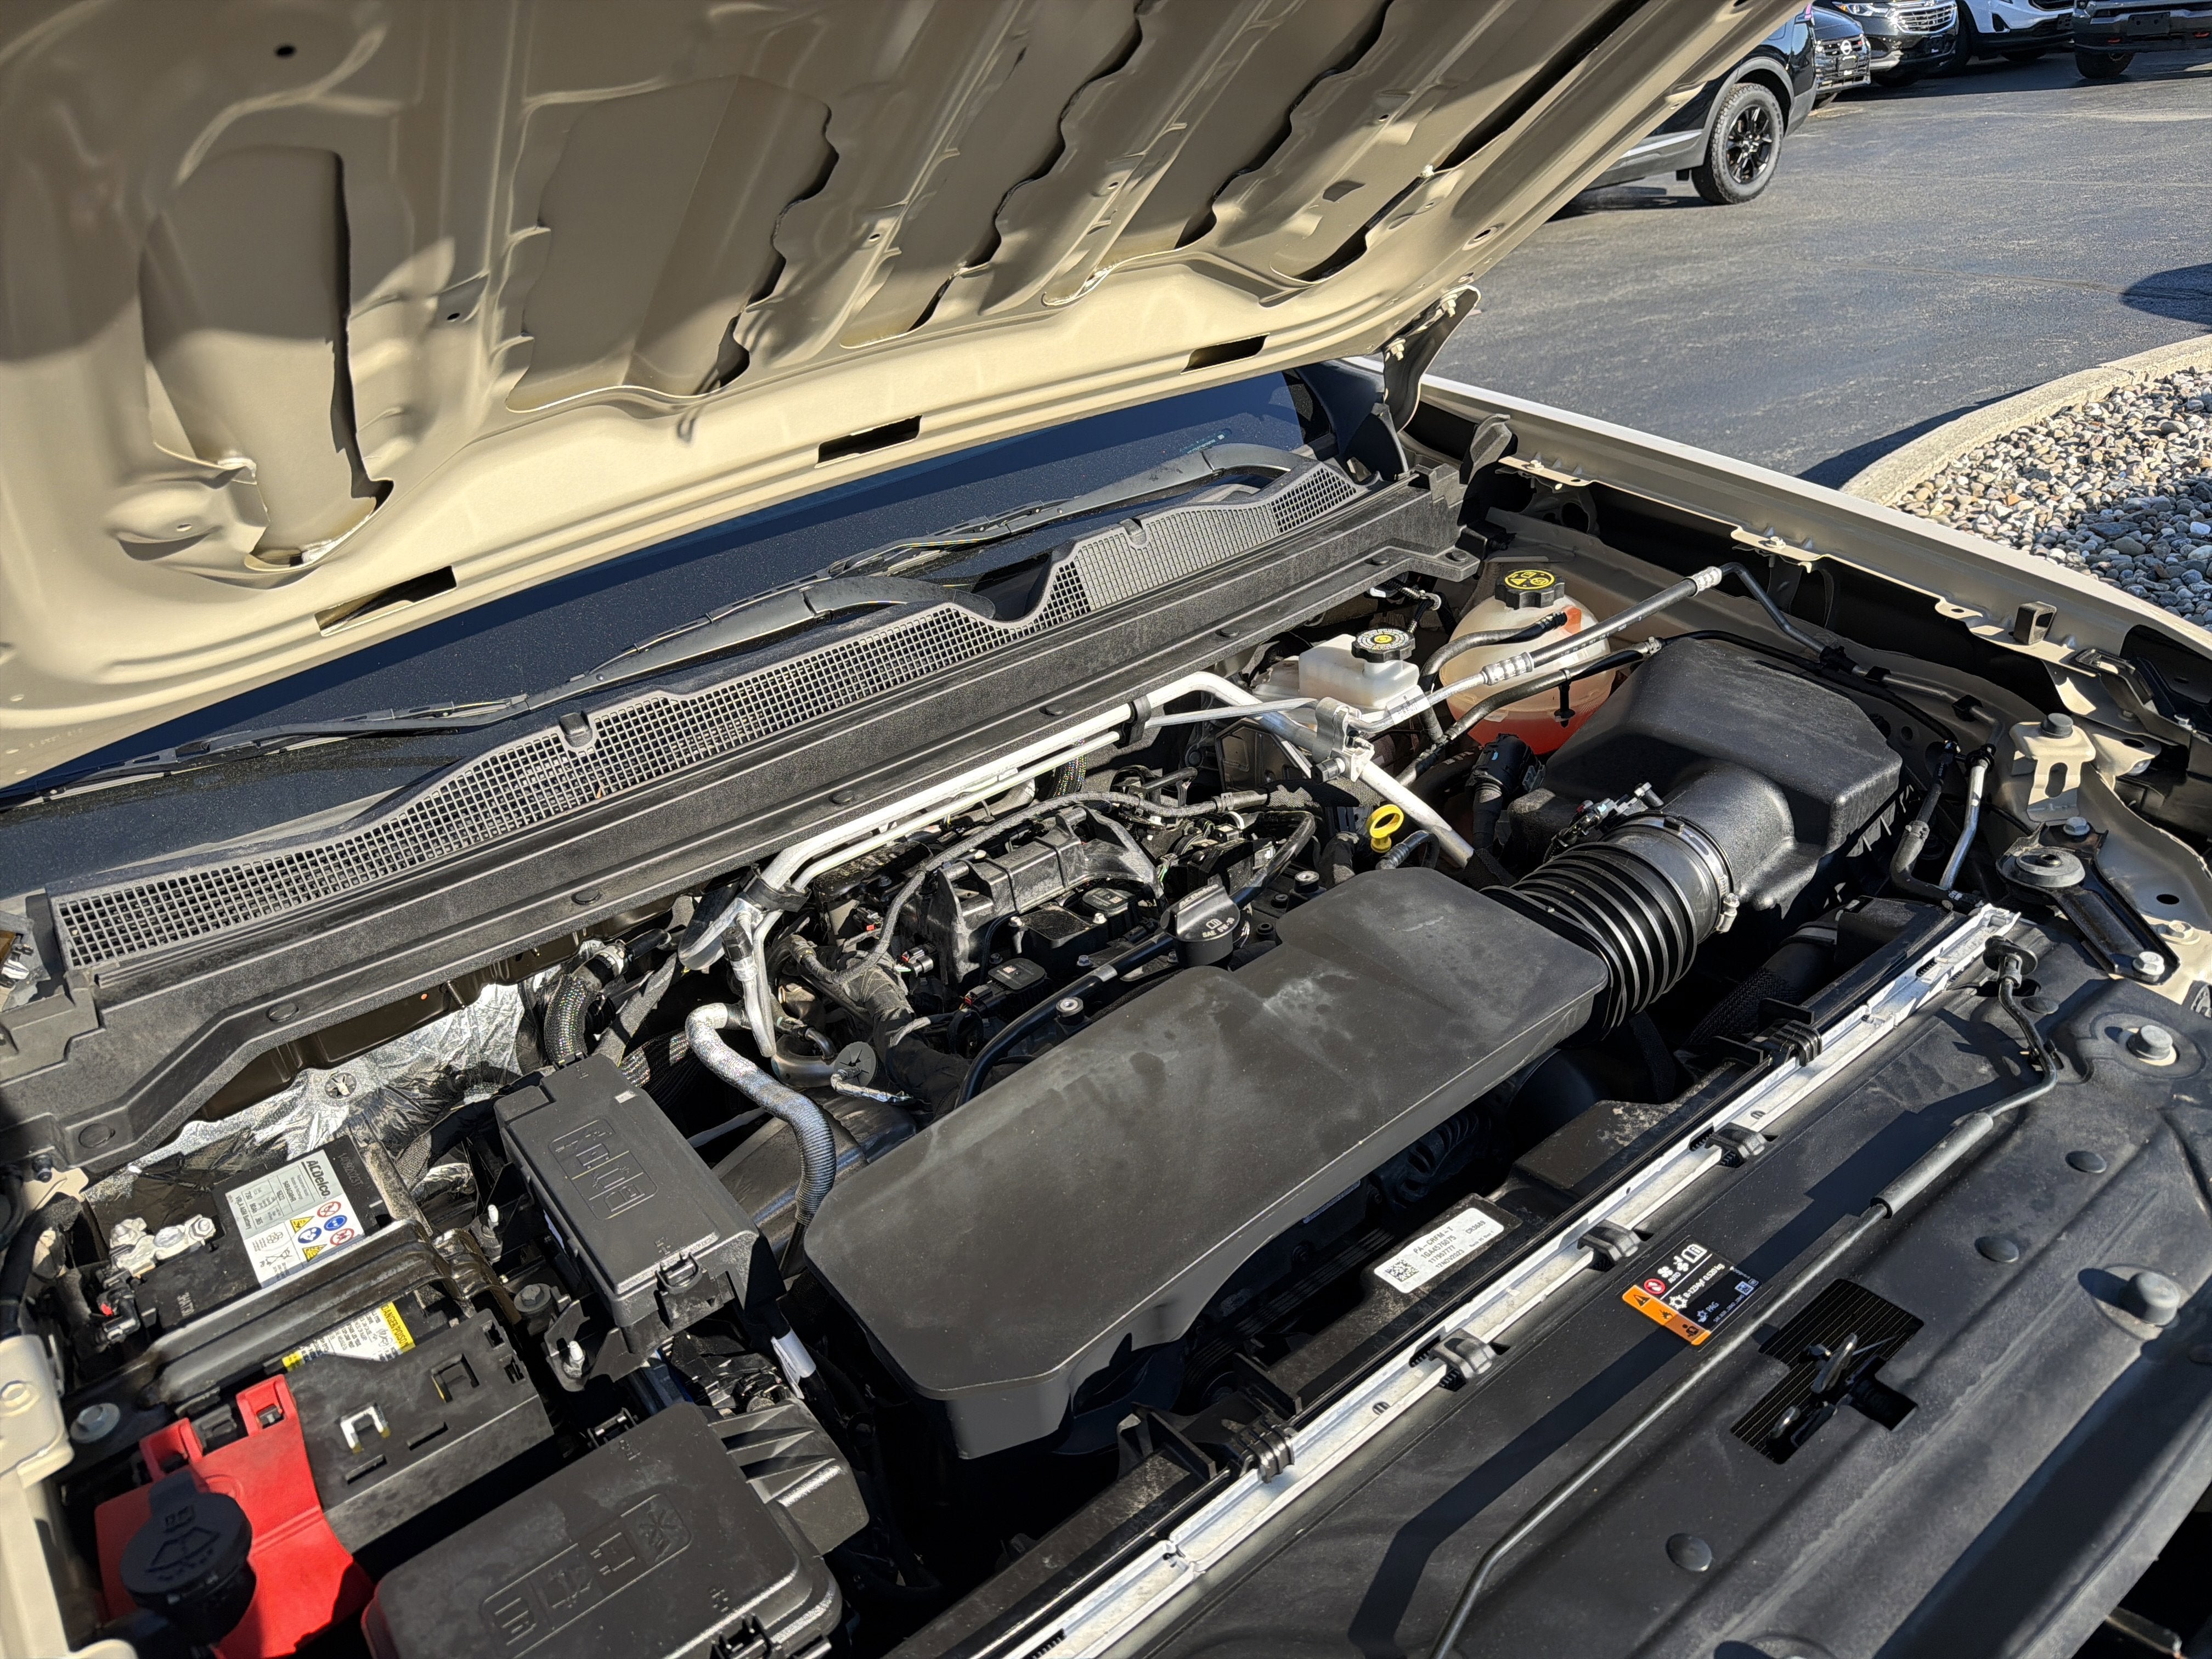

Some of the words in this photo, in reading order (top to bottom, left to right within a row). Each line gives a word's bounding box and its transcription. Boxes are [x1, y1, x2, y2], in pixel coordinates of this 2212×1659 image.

[1180, 884, 1218, 908] ACDelco
[1217, 917, 1234, 933] 5W-30
[306, 1160, 331, 1198] ACDelco
[242, 1215, 252, 1229] Battery
[1713, 1262, 1725, 1271] kg
[1667, 1271, 1681, 1283] AUTO
[1705, 1300, 1719, 1312] PAG
[381, 1304, 409, 1348] DANGER/POISON
